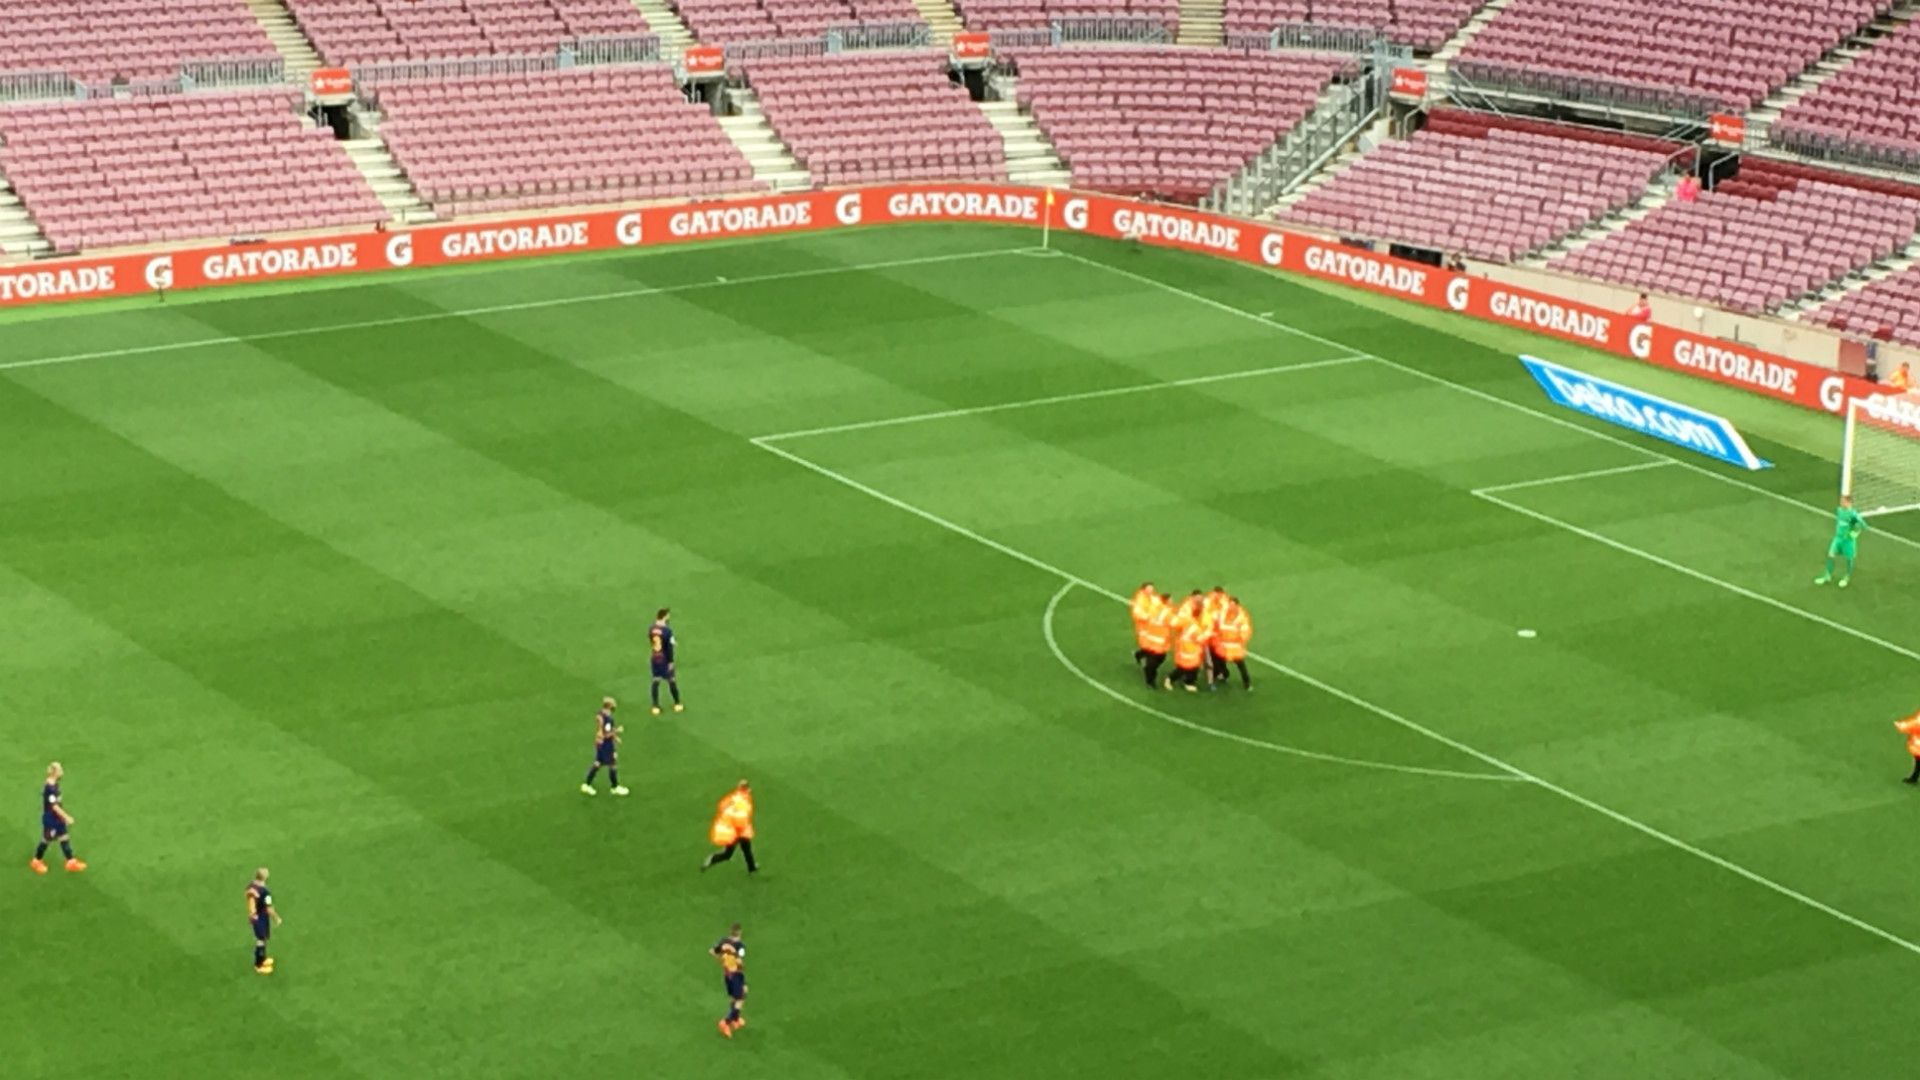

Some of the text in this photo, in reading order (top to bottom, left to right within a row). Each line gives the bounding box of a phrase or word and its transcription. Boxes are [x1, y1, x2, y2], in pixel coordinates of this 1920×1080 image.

[0, 192, 1037, 299] TORADE G GATORADE G GATORADE G GATORADE G GATORADE
[1064, 200, 1088, 229] G
[1113, 209, 1239, 251] GATORADE
[1261, 233, 1284, 264] G
[1305, 246, 1425, 295] GATORADE
[1447, 278, 1470, 310] G
[1490, 291, 1610, 342] GATORADE
[1629, 325, 1653, 358] G
[1674, 339, 1798, 395] GATORADE
[1820, 376, 1844, 411] G
